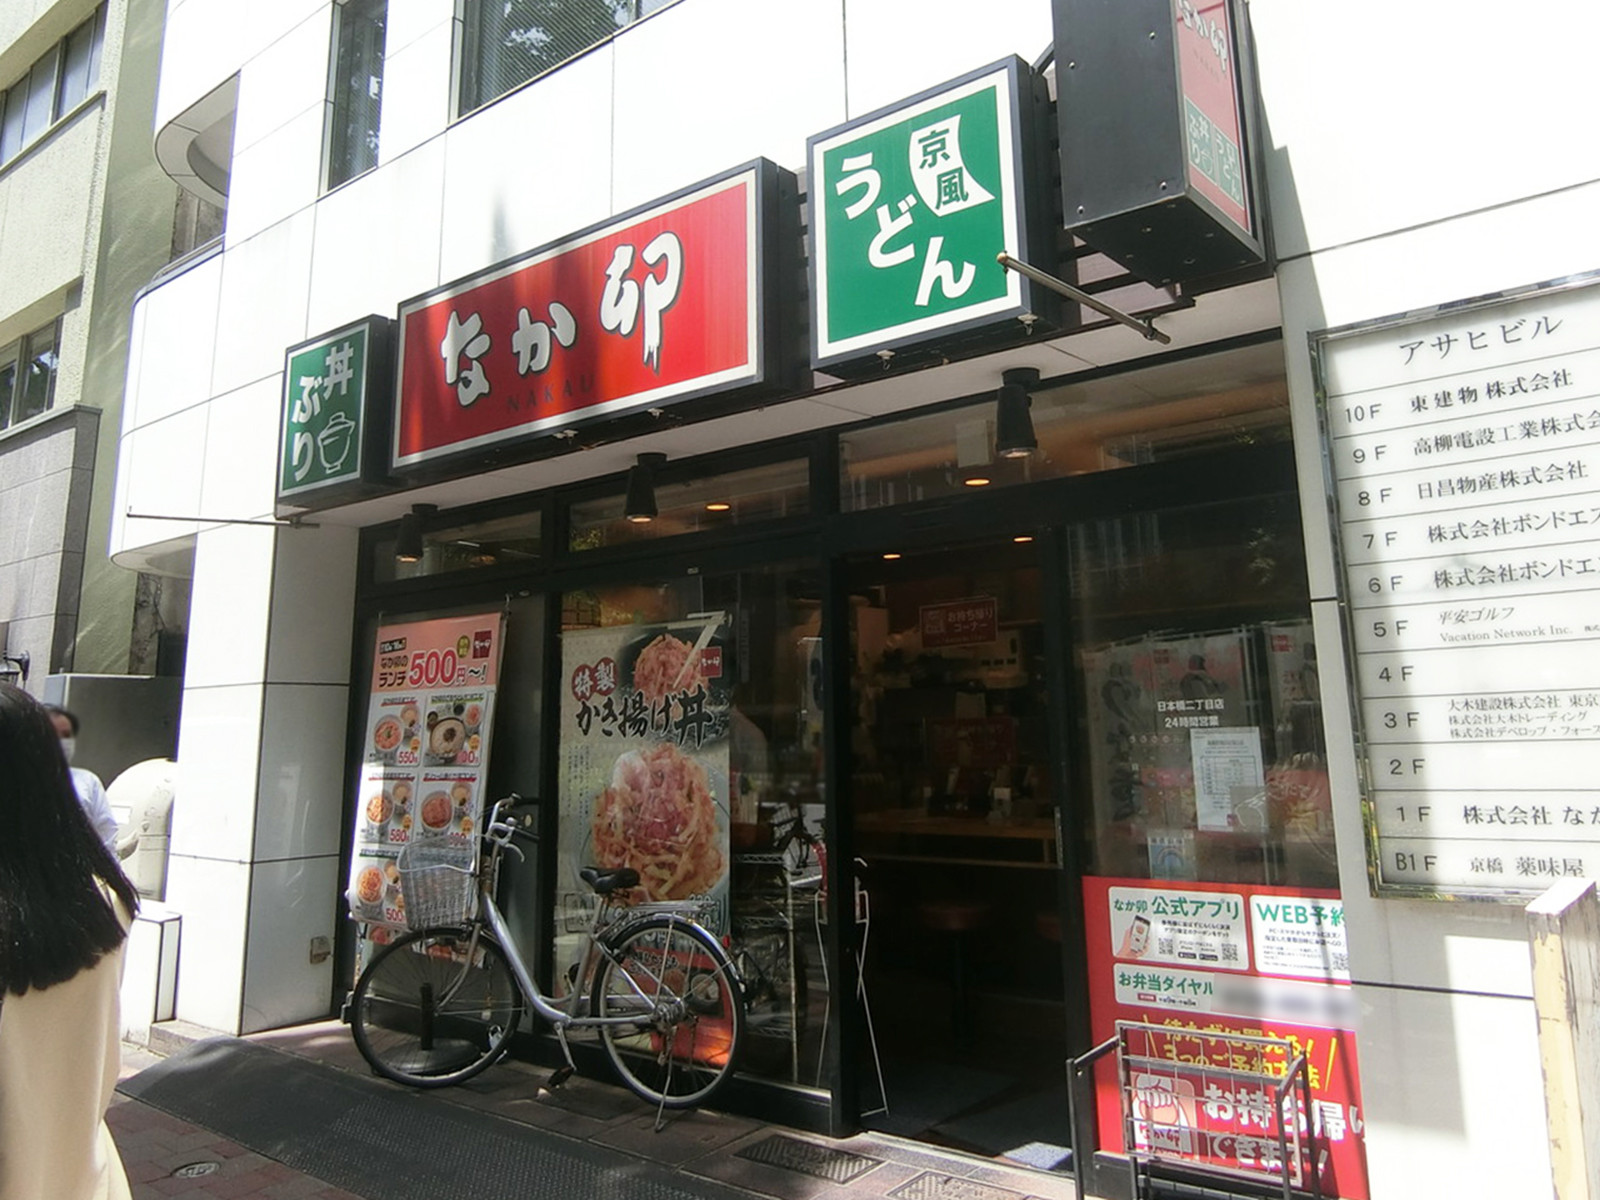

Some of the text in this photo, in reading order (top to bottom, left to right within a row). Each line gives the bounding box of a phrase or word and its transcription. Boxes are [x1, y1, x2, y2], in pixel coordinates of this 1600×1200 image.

[918, 128, 969, 209] 京風
[835, 151, 976, 306] うどん
[441, 231, 683, 407] なか卯
[1399, 315, 1563, 366] アサヒビル
[506, 373, 595, 412] NAKAU
[1345, 403, 1382, 423] 10F
[1417, 460, 1589, 501] 日昌物産株式会社
[1433, 558, 1600, 590] 株式会社ボンドエ
[1438, 605, 1515, 626] 平安ゴルフ
[1439, 630, 1490, 643] Vacation
[1494, 626, 1546, 640] Network
[1550, 624, 1573, 636] Inc.
[379, 671, 407, 688] ランチ
[575, 661, 615, 697] 特製
[576, 683, 713, 750] かき揚げ丼
[1157, 699, 1224, 712] 日本橋二丁目店
[1164, 716, 1219, 728] 24時間営業
[1395, 852, 1585, 878] B1F 京橋 薬味屋
[1114, 896, 1239, 920] なか卯 公式アプリ
[1119, 971, 1214, 995] お弁当ダイヤル
